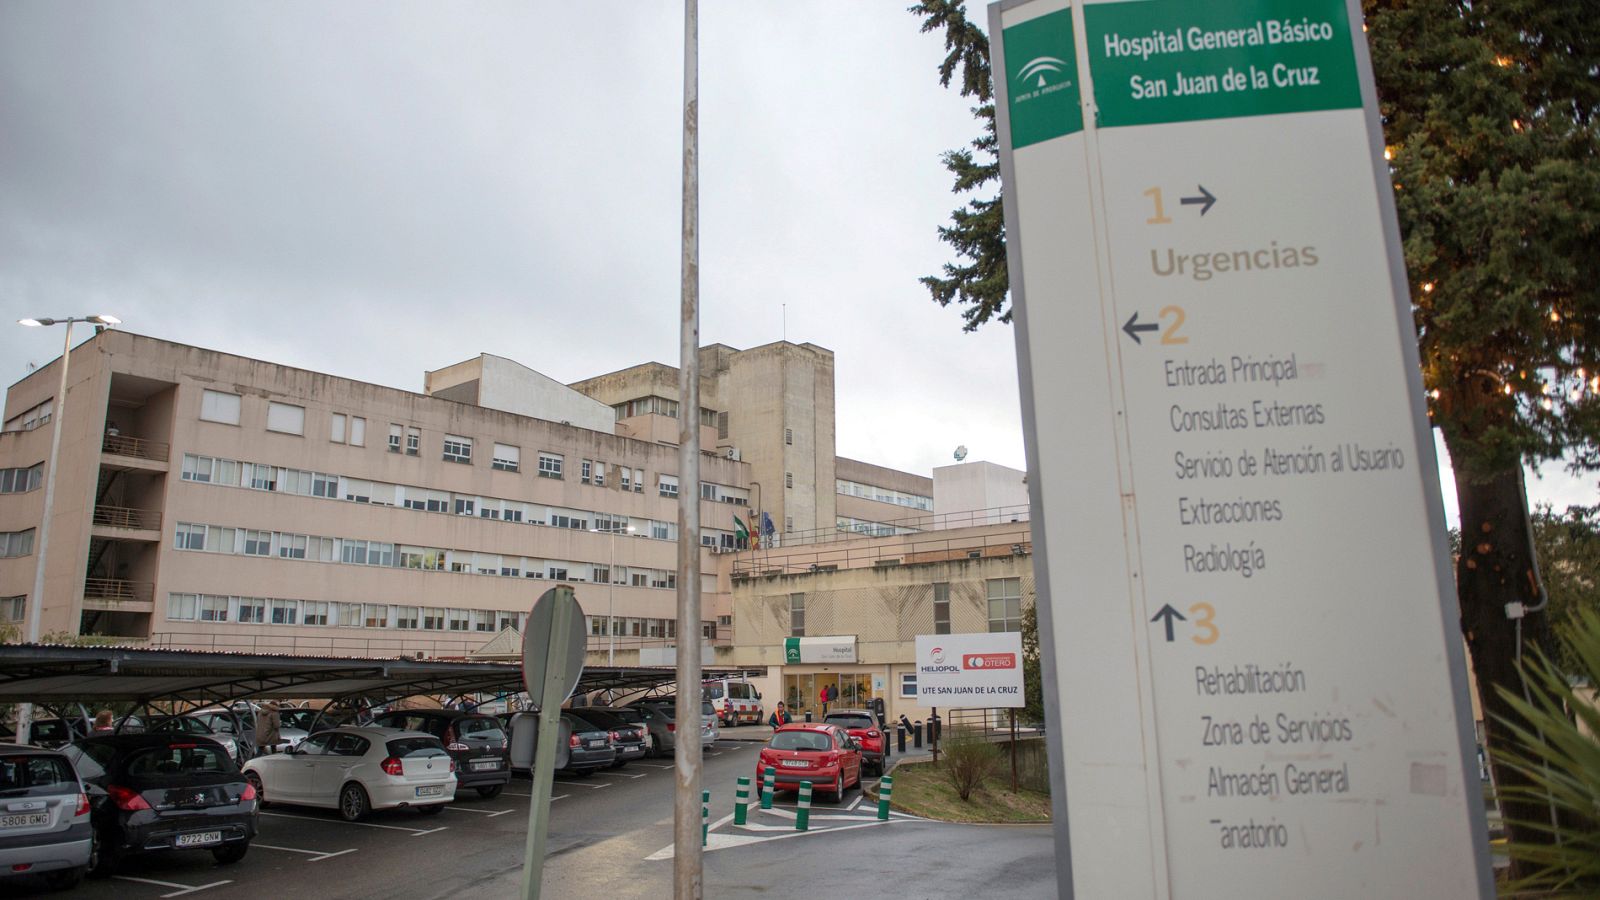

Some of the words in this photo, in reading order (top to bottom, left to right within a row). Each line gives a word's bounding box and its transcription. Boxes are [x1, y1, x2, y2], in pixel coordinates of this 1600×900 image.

[1104, 28, 1184, 60] Hospital
[1187, 21, 1264, 51] General
[1267, 17, 1333, 44] Básico
[1130, 75, 1167, 99] San
[1172, 72, 1218, 96] Juan
[1222, 67, 1247, 92] de
[1250, 65, 1269, 89] la
[1272, 63, 1320, 87] Cruz
[1143, 186, 1173, 225] 1
[1151, 241, 1319, 281] Urgencias
[1158, 304, 1189, 345] 2
[1165, 358, 1226, 387] Entrada
[1231, 353, 1298, 387] Principal
[1170, 403, 1248, 432] Consultas
[1252, 400, 1326, 427] Externas
[1174, 450, 1232, 479] Servicio
[1238, 449, 1257, 476] de
[1263, 444, 1326, 475] Atención
[1331, 444, 1344, 473] al
[1347, 442, 1404, 471] Usuario
[1178, 497, 1283, 525] Extracciones
[1183, 541, 1265, 578] Radiología
[1188, 602, 1221, 646] 3
[984, 659, 1011, 667] OTERO
[1195, 662, 1306, 695] Rehabilitación
[937, 686, 952, 694] SAN
[953, 686, 973, 694] JUAN
[975, 686, 985, 694] DE
[987, 686, 996, 694] LA
[998, 686, 1018, 694] CRUZ
[1201, 716, 1243, 746] Zona
[1249, 715, 1270, 744] de
[1277, 712, 1352, 743] Servicios
[1208, 765, 1279, 797] Almacén
[1284, 763, 1349, 795] General
[181, 834, 202, 844] 9722
